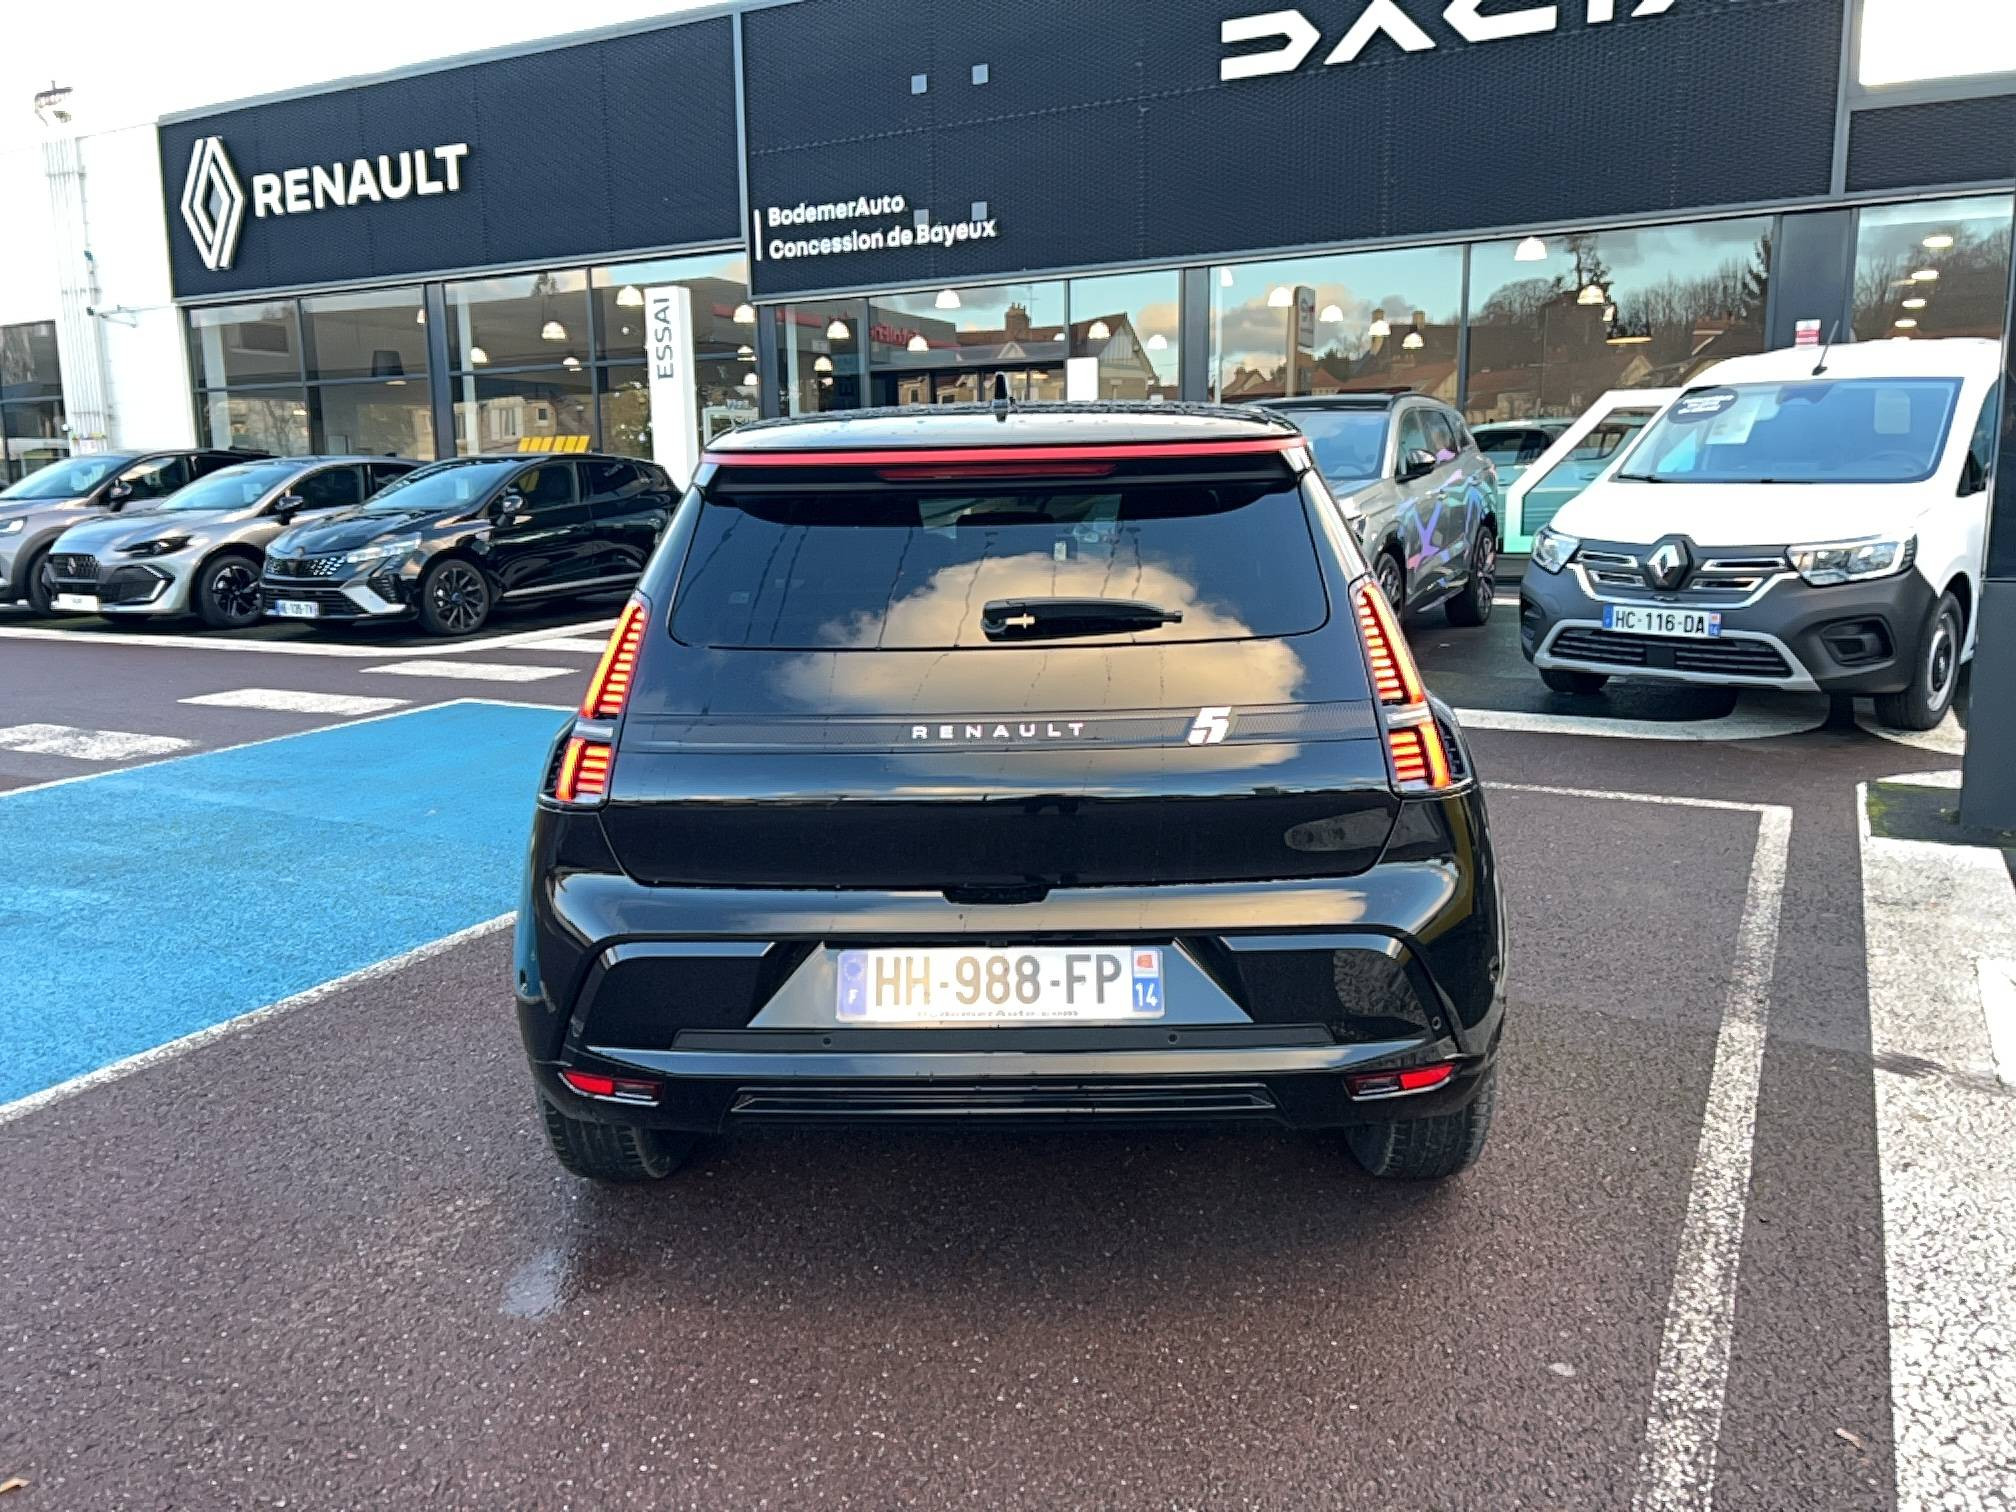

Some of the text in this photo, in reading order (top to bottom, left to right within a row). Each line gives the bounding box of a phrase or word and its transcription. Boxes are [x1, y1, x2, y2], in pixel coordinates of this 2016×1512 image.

[1220, 0, 1676, 81] DAC
[252, 143, 468, 218] RENAULT
[767, 194, 906, 228] BodemerAuto
[768, 218, 997, 260] Concession de Bayeux
[653, 298, 674, 379] ESSAI
[1615, 610, 1705, 634] HC-116-DA
[911, 722, 1085, 739] RENAULT
[1187, 706, 1232, 745] 5
[875, 954, 1122, 1007] HH-988-FP
[1134, 982, 1158, 1008] 14
